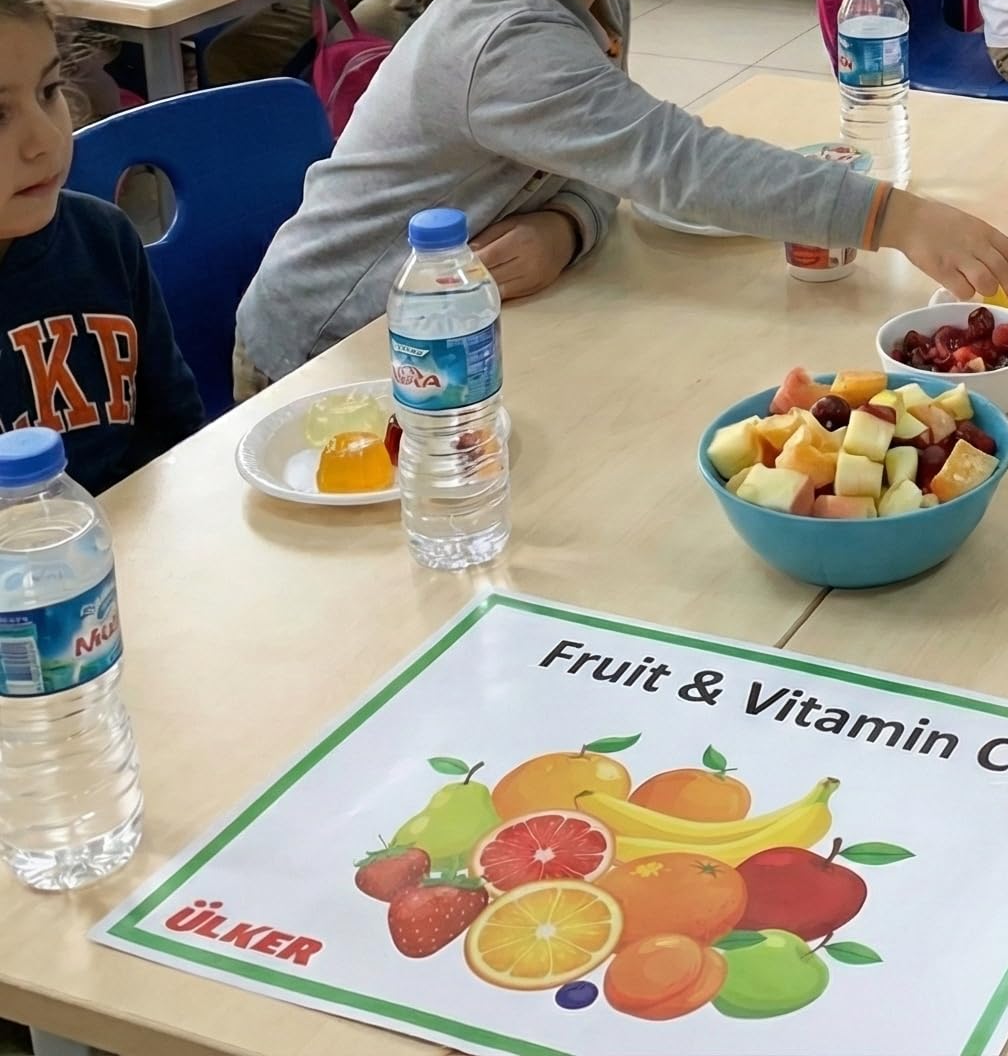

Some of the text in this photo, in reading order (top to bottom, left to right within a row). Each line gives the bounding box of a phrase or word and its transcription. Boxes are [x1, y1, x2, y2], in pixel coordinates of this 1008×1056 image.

[538, 640, 672, 693] Fruit
[677, 670, 724, 706] &
[744, 681, 960, 759] Vitamin
[165, 899, 324, 966] ÜLKER
